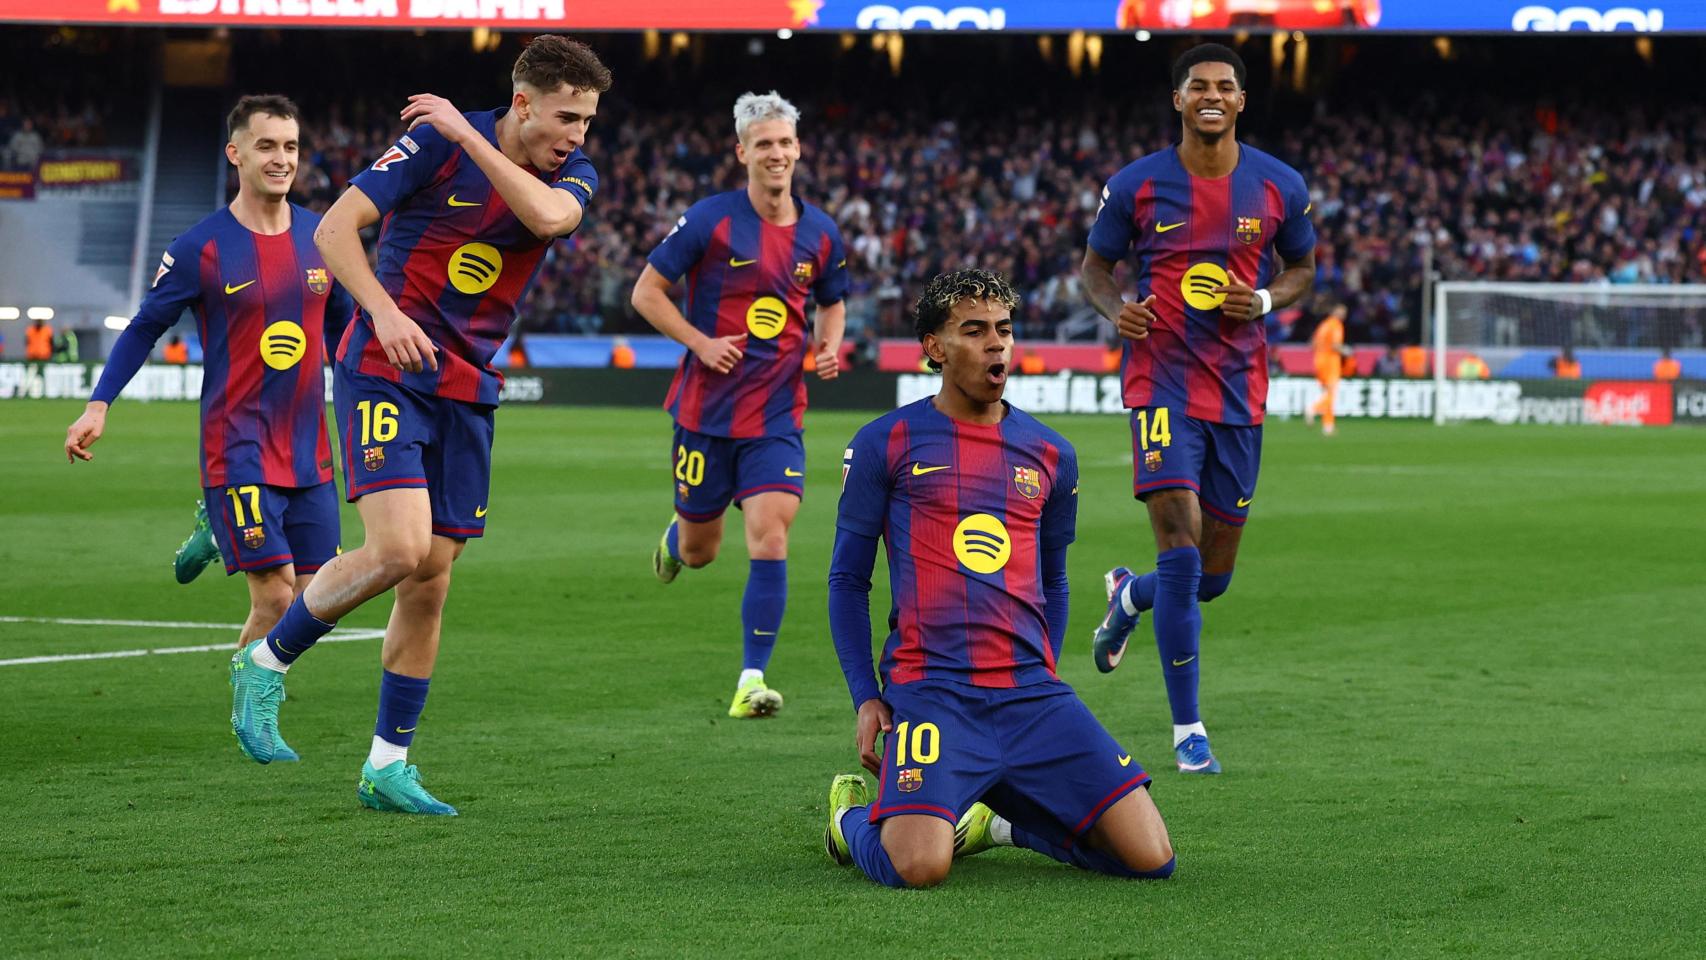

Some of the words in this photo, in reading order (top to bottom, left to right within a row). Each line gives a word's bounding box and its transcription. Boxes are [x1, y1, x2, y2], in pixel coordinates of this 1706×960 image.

[357, 400, 399, 446] 16
[1137, 407, 1171, 450] 14
[675, 444, 705, 486] 20
[226, 485, 263, 527] 17
[896, 721, 940, 767] 10
